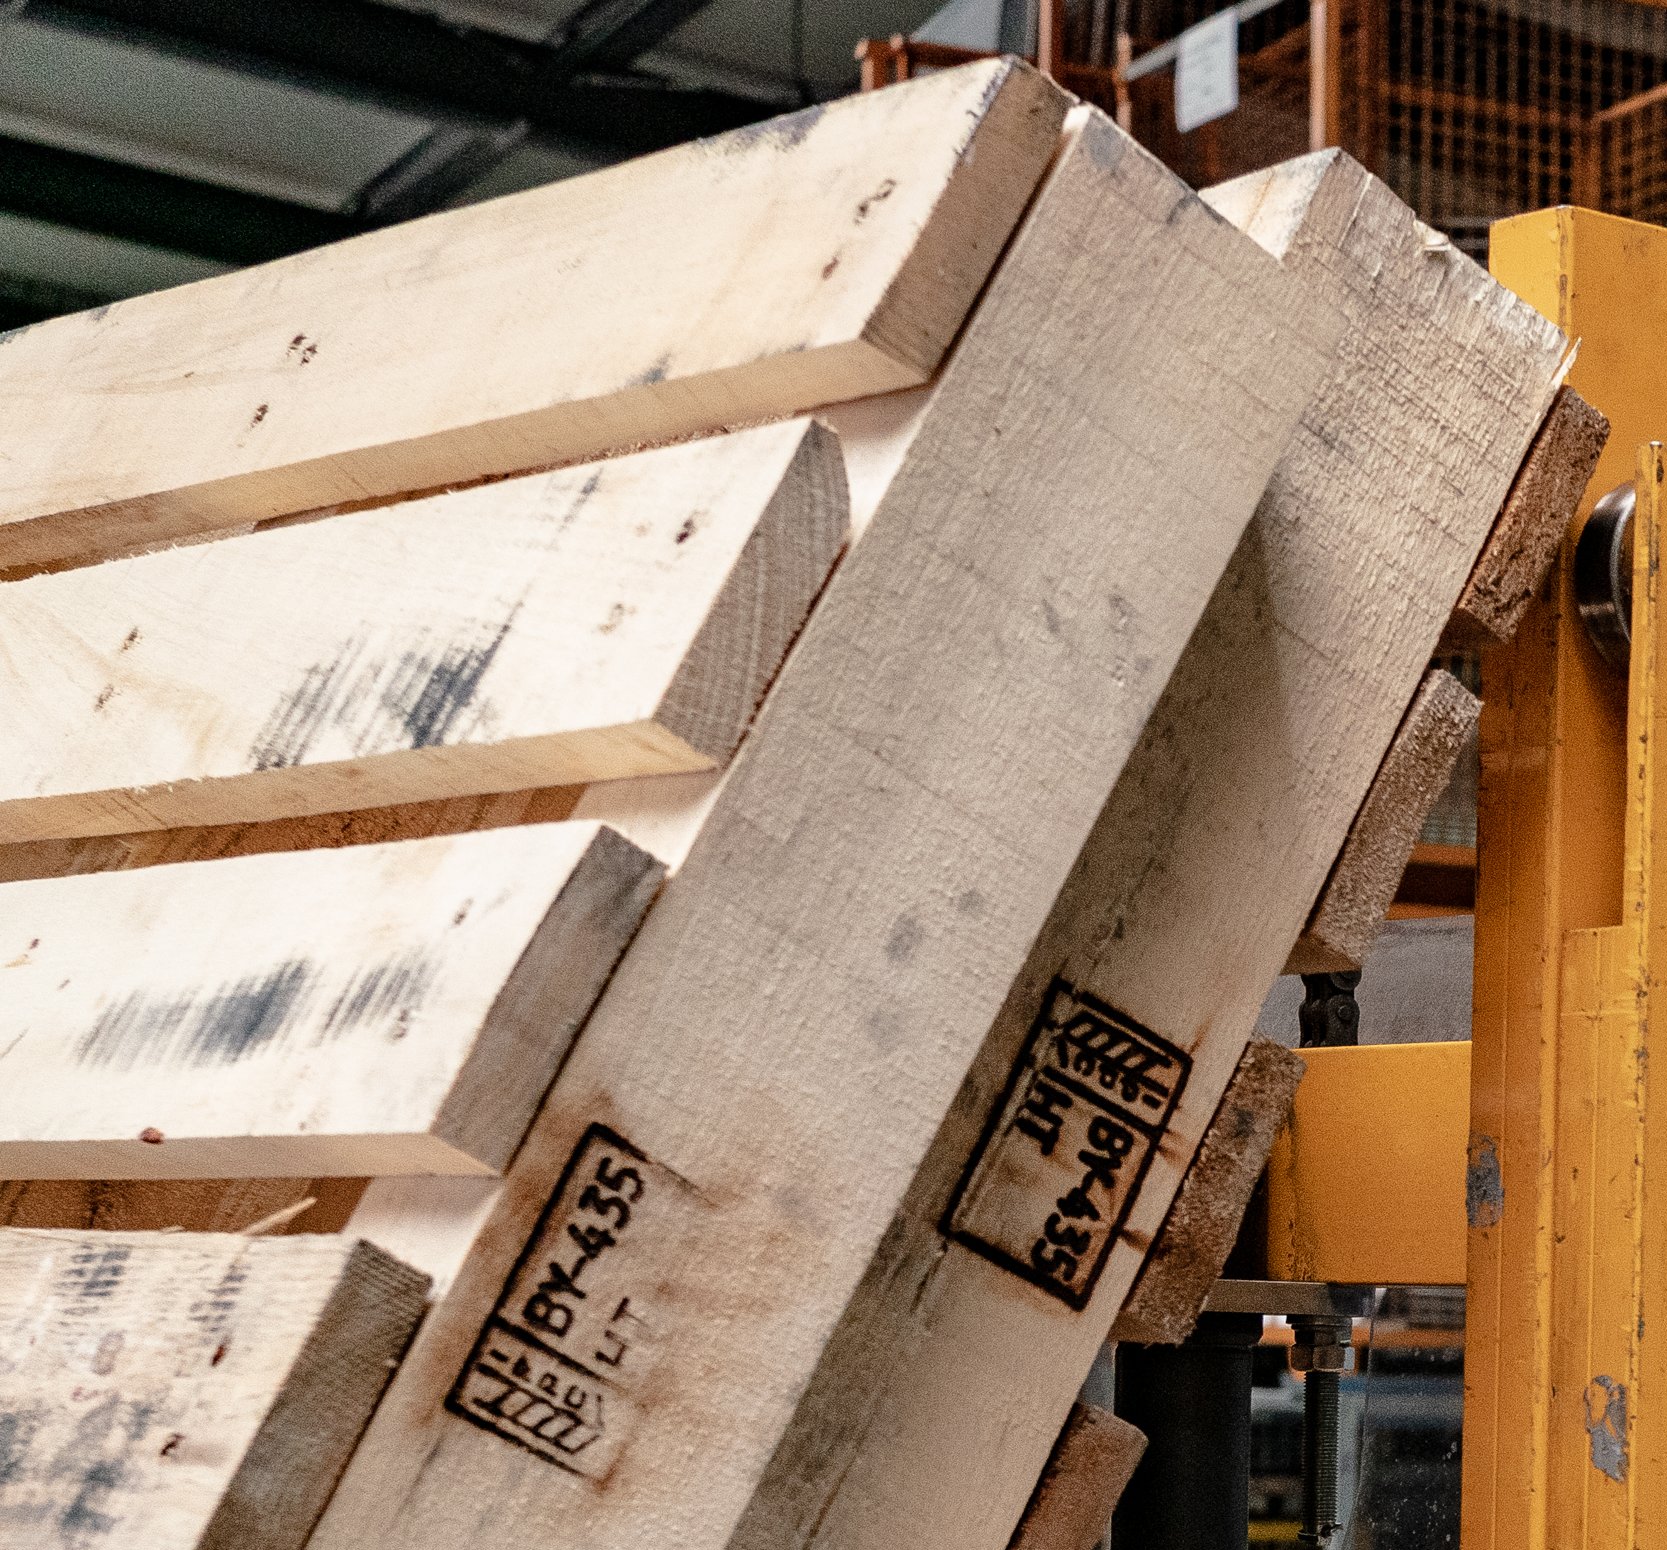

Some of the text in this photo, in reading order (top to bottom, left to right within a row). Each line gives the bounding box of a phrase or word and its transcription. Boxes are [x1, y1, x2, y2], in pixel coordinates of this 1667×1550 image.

[1015, 1079, 1074, 1158] HT
[1030, 1114, 1135, 1283] BY-435
[521, 1155, 645, 1339] BY-435
